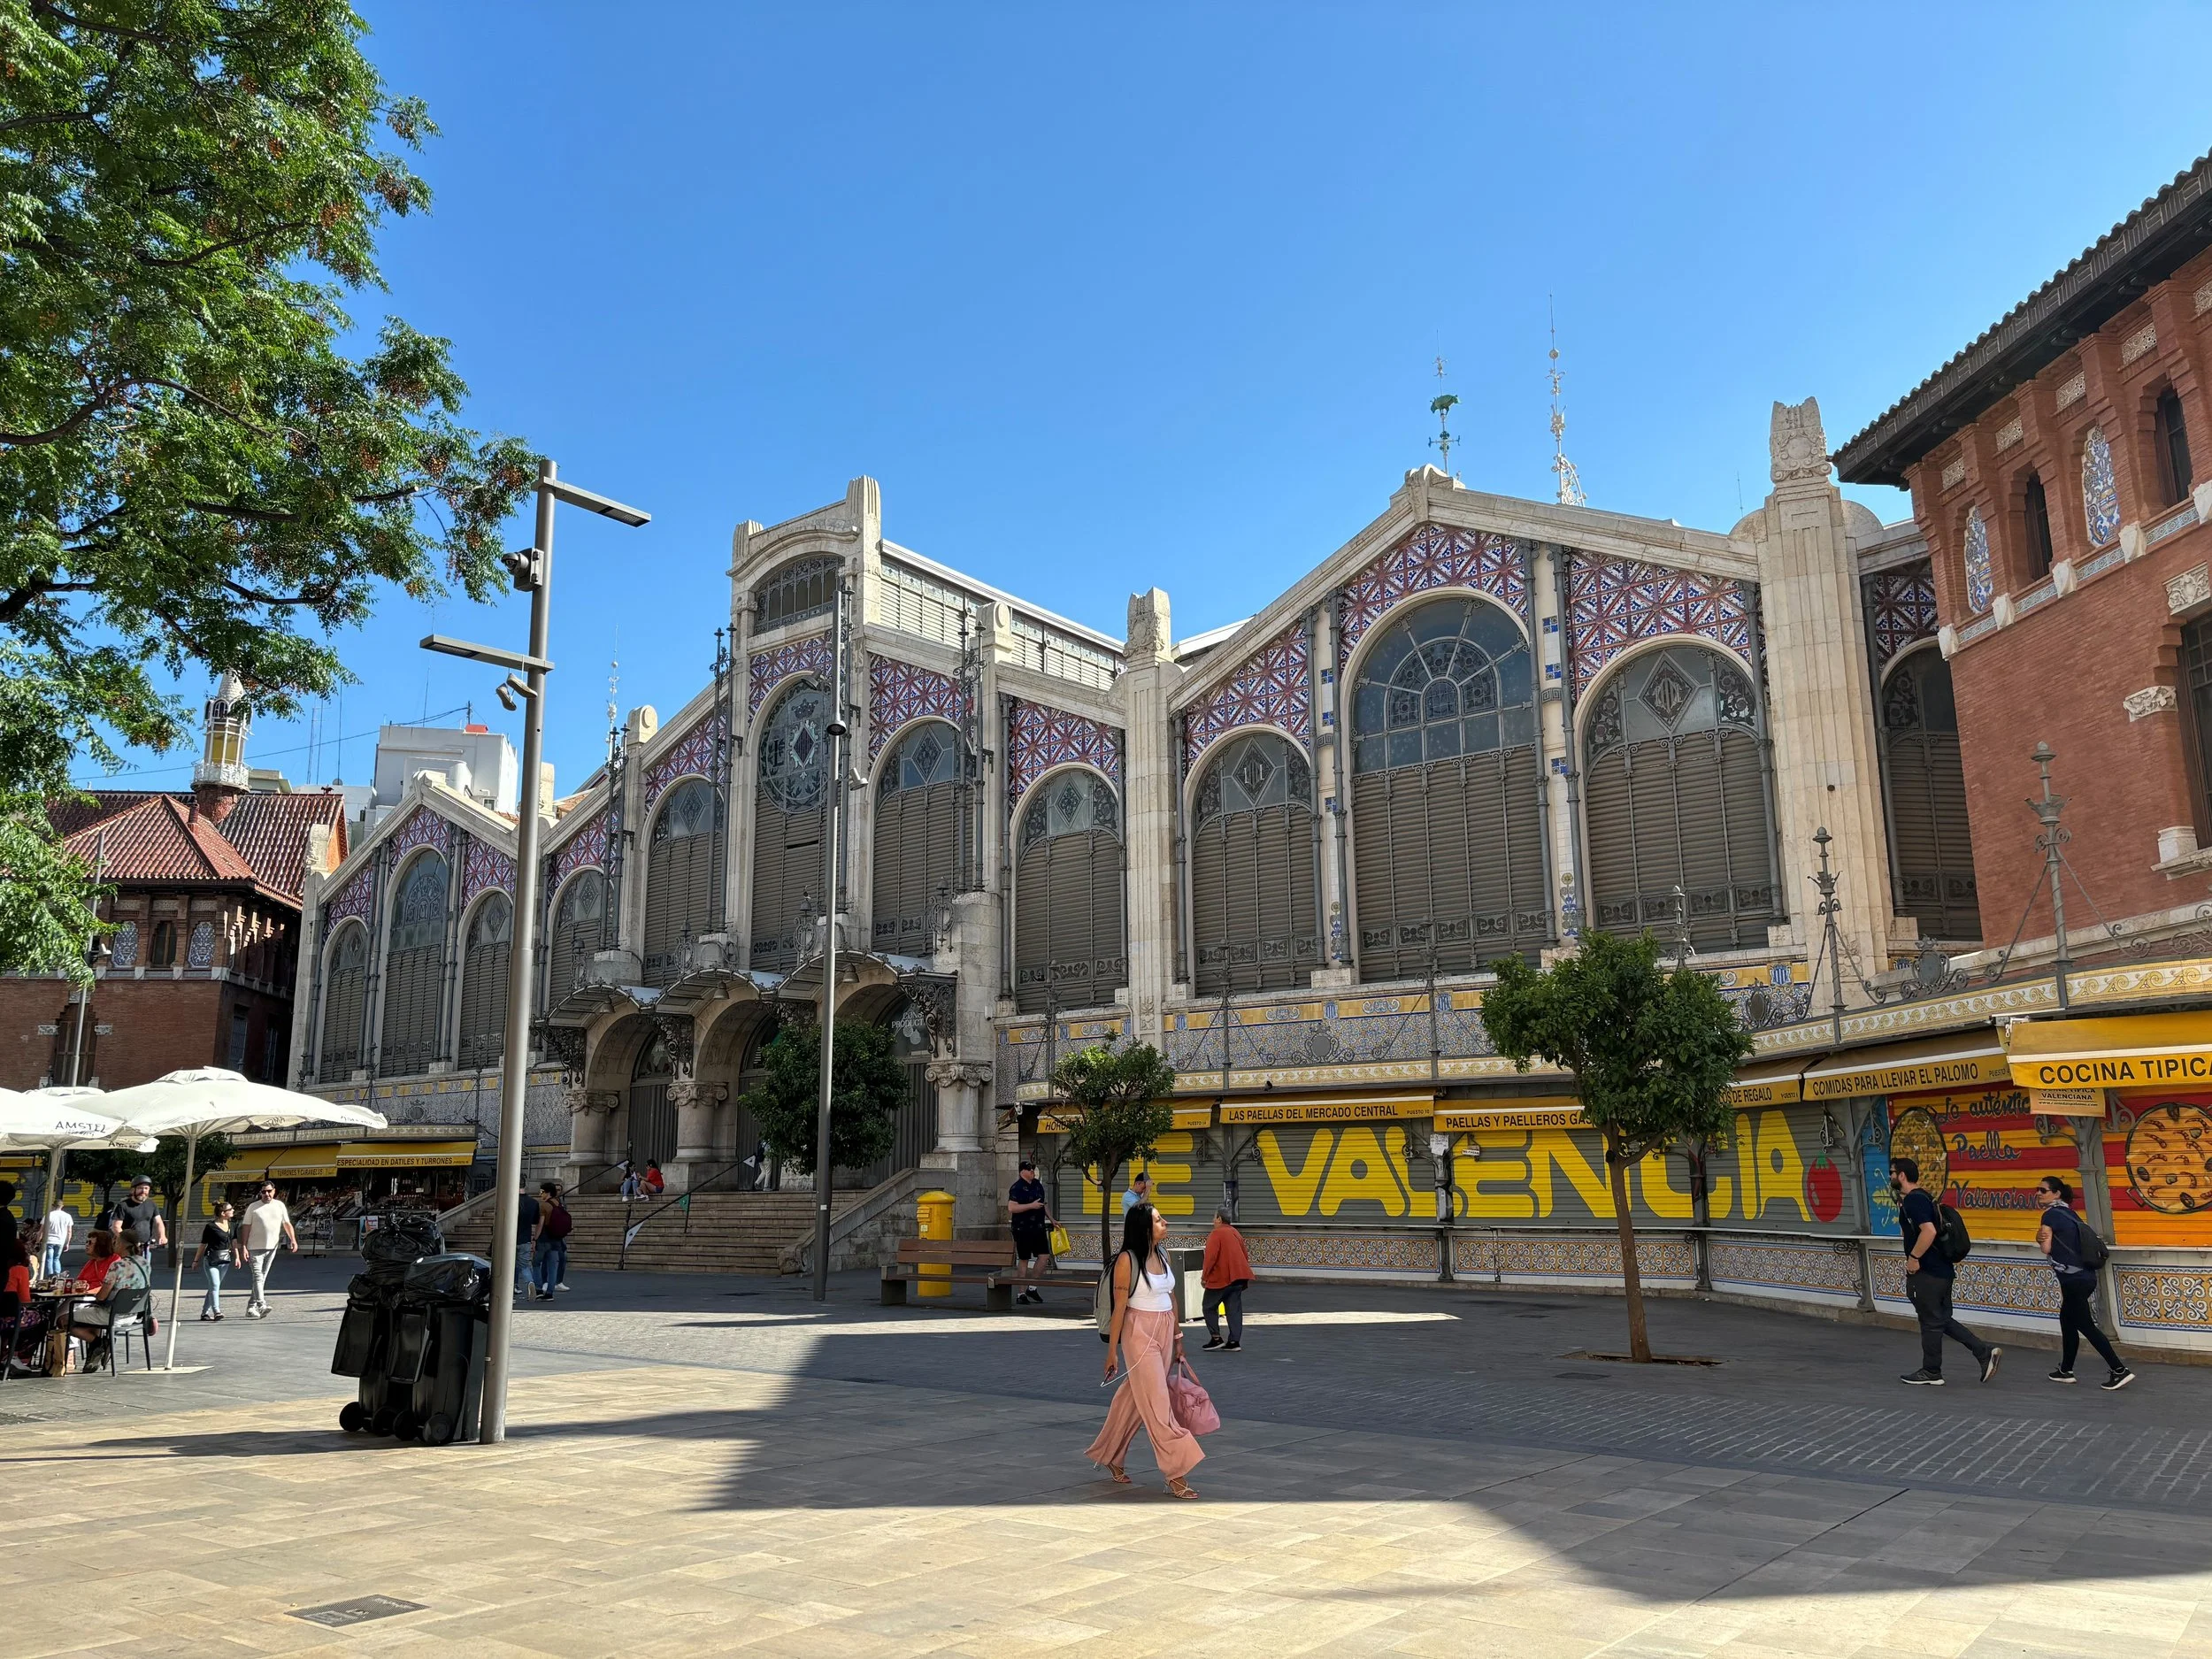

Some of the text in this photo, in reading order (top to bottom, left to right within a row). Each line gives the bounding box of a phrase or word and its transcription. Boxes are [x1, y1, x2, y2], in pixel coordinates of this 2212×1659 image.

[1813, 1078, 1853, 1096] COMIDAS
[1855, 1074, 1879, 1091] PARA
[1880, 1070, 1916, 1088] LLEVAR
[1920, 1068, 1932, 1085] EL
[1934, 1063, 1978, 1083] PALOMO
[2039, 1056, 2212, 1084] COCINA TIPIC
[1733, 1089, 1742, 1102] DE
[1744, 1087, 1772, 1102] REGALO
[1969, 1090, 2031, 1118] auténtic
[1229, 1110, 1245, 1121] LAS
[1247, 1109, 1284, 1120] PAELLAS
[1286, 1108, 1303, 1119] DEL
[1305, 1107, 1351, 1118] MERCADO
[1354, 1105, 1398, 1117] CENTRAL
[1446, 1117, 1491, 1128] PAELLAS
[1491, 1116, 1500, 1127] Y
[1504, 1114, 1566, 1126] PAELLEROS
[55, 1120, 106, 1133] AMSTEL
[1951, 1130, 2021, 1160] Paella
[336, 1157, 380, 1166] ESPECIALIDAD
[380, 1157, 389, 1166] EN
[1951, 1179, 2044, 1210] Valencian
